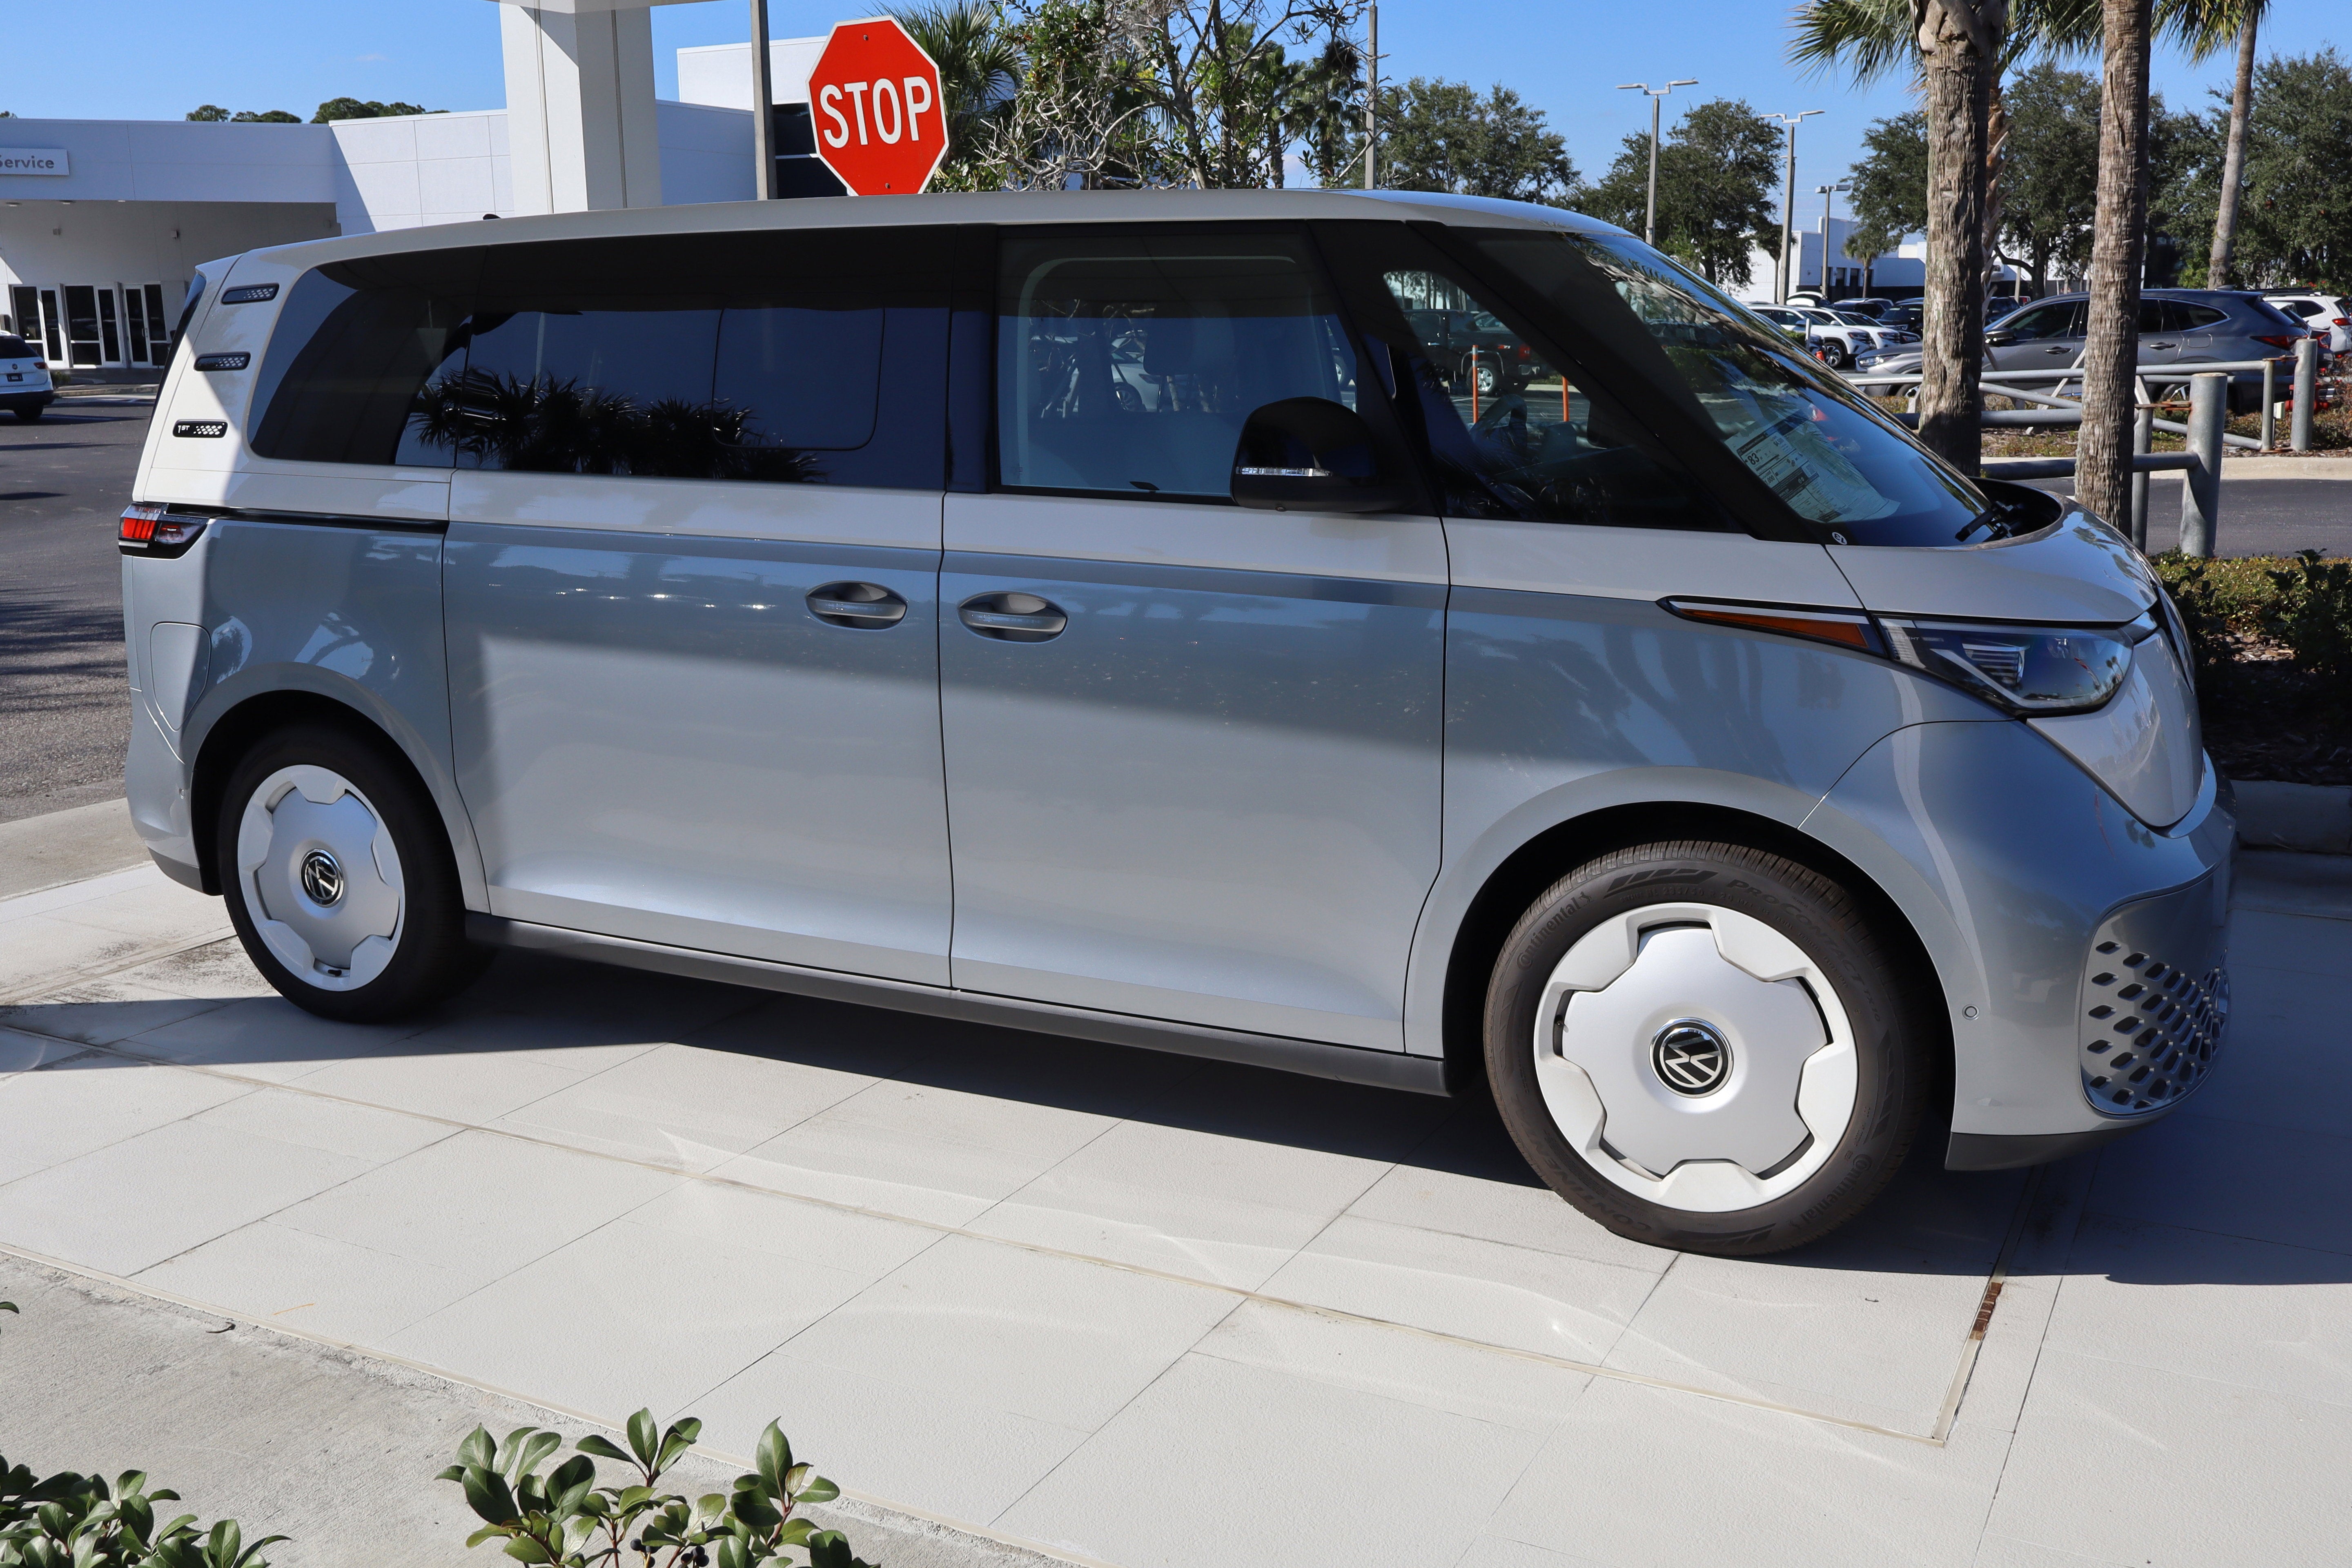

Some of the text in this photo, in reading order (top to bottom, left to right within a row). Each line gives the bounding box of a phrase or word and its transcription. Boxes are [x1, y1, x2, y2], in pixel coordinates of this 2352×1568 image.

[820, 76, 932, 149] STOP
[1748, 453, 1759, 465] 83
[1513, 896, 1583, 972] Continental
[1797, 1150, 1875, 1227] Continental
